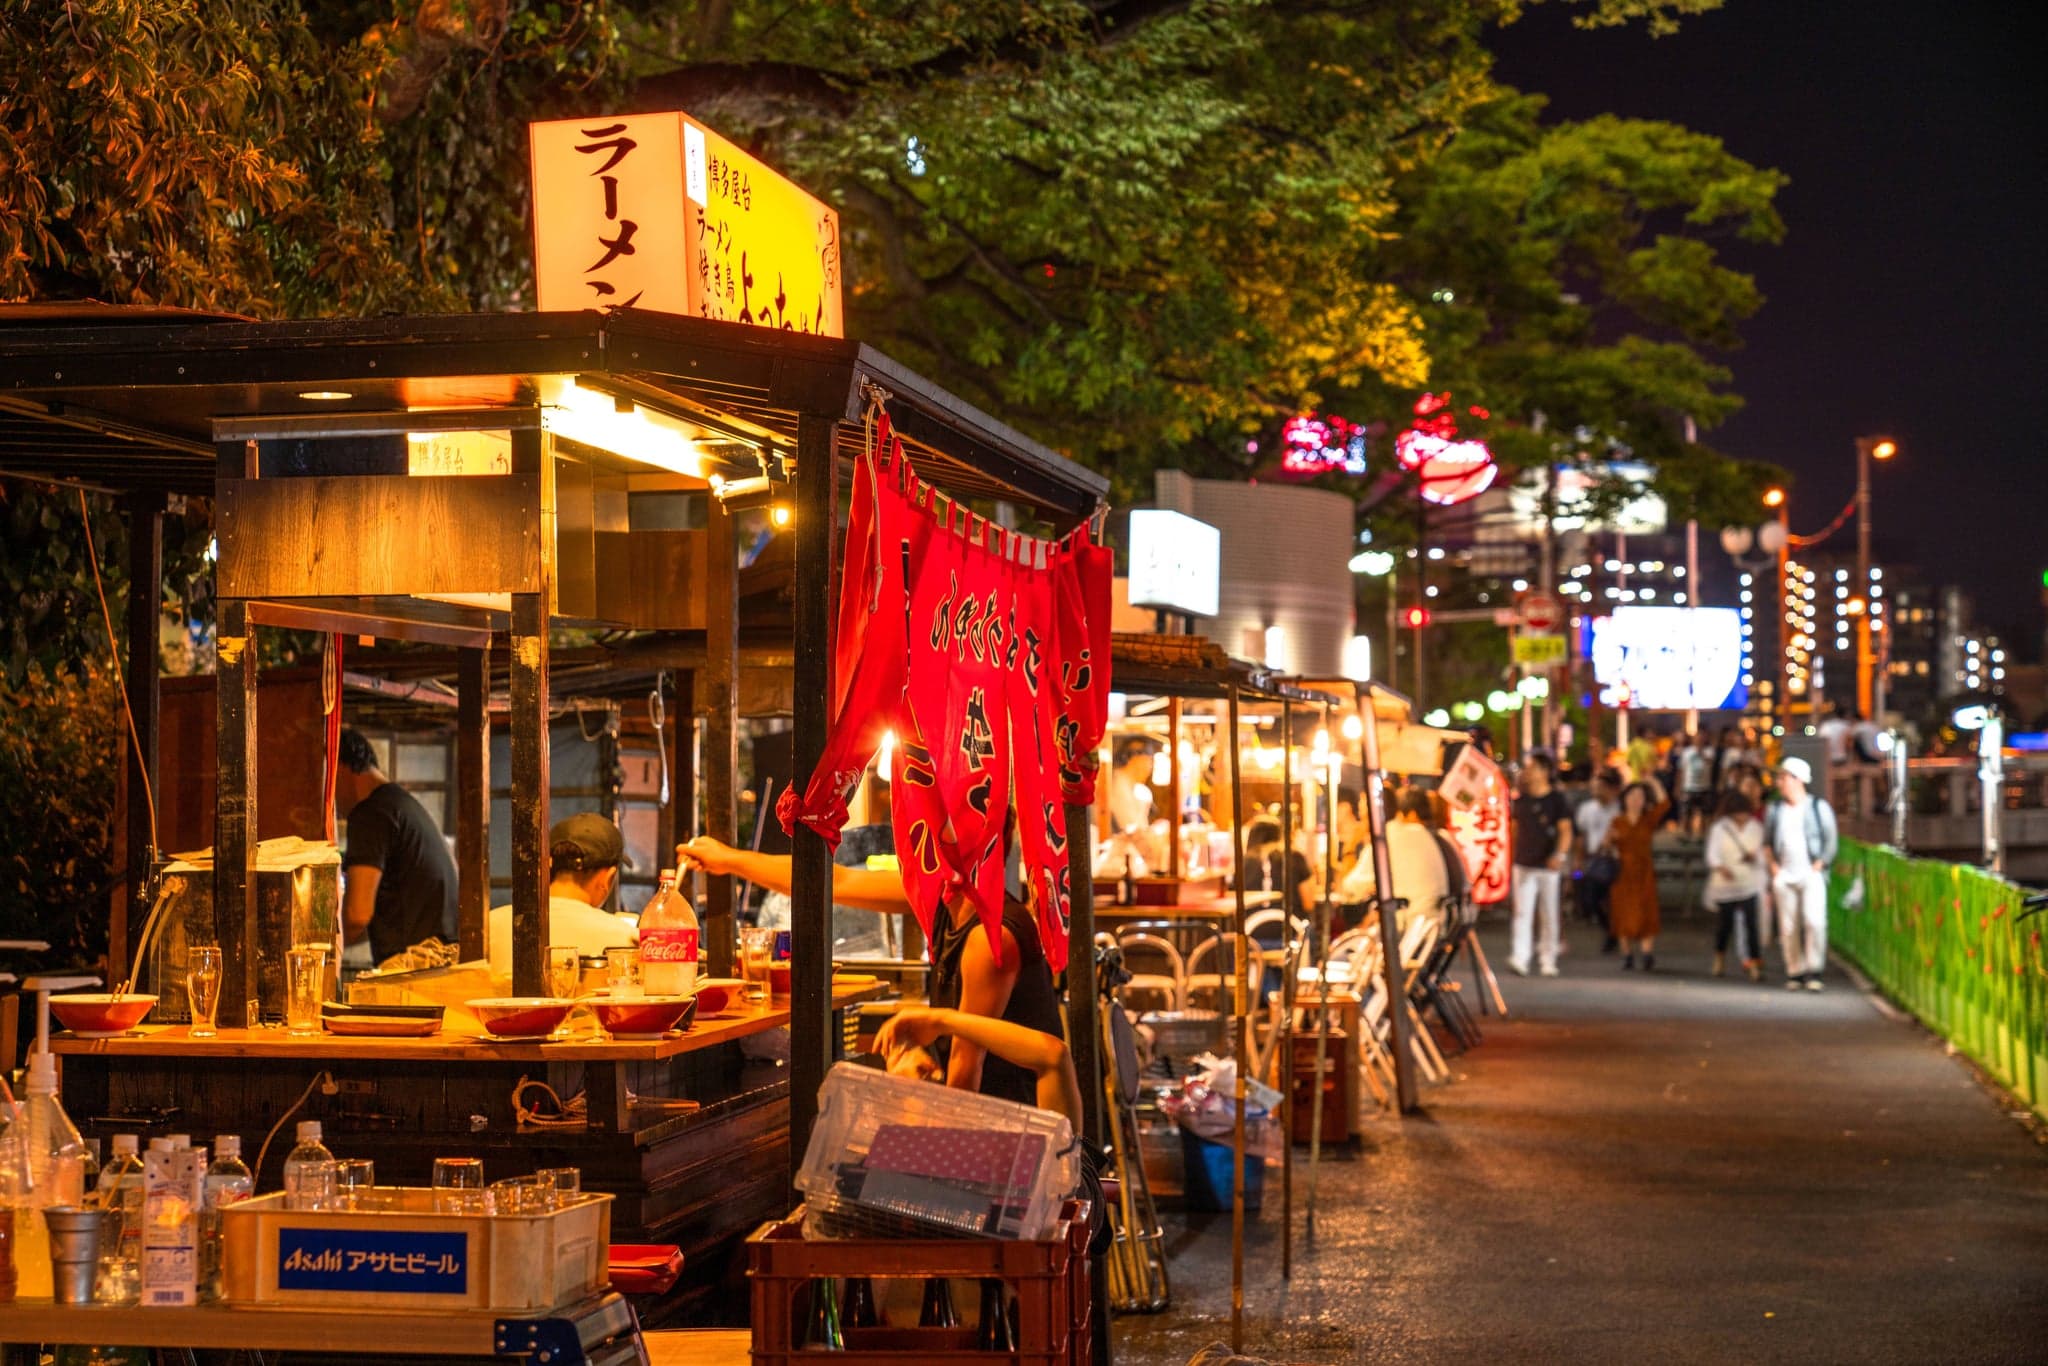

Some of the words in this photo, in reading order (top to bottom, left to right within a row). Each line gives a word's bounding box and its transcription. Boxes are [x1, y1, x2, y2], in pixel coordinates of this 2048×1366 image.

[709, 154, 751, 212] 博多屋台
[574, 123, 644, 309] ラーメン
[697, 208, 732, 255] ラーメン
[699, 249, 735, 304] 焼き鳥
[1473, 802, 1505, 887] おでん
[284, 1248, 343, 1273] Asahi
[346, 1251, 460, 1275] アサヒビール
